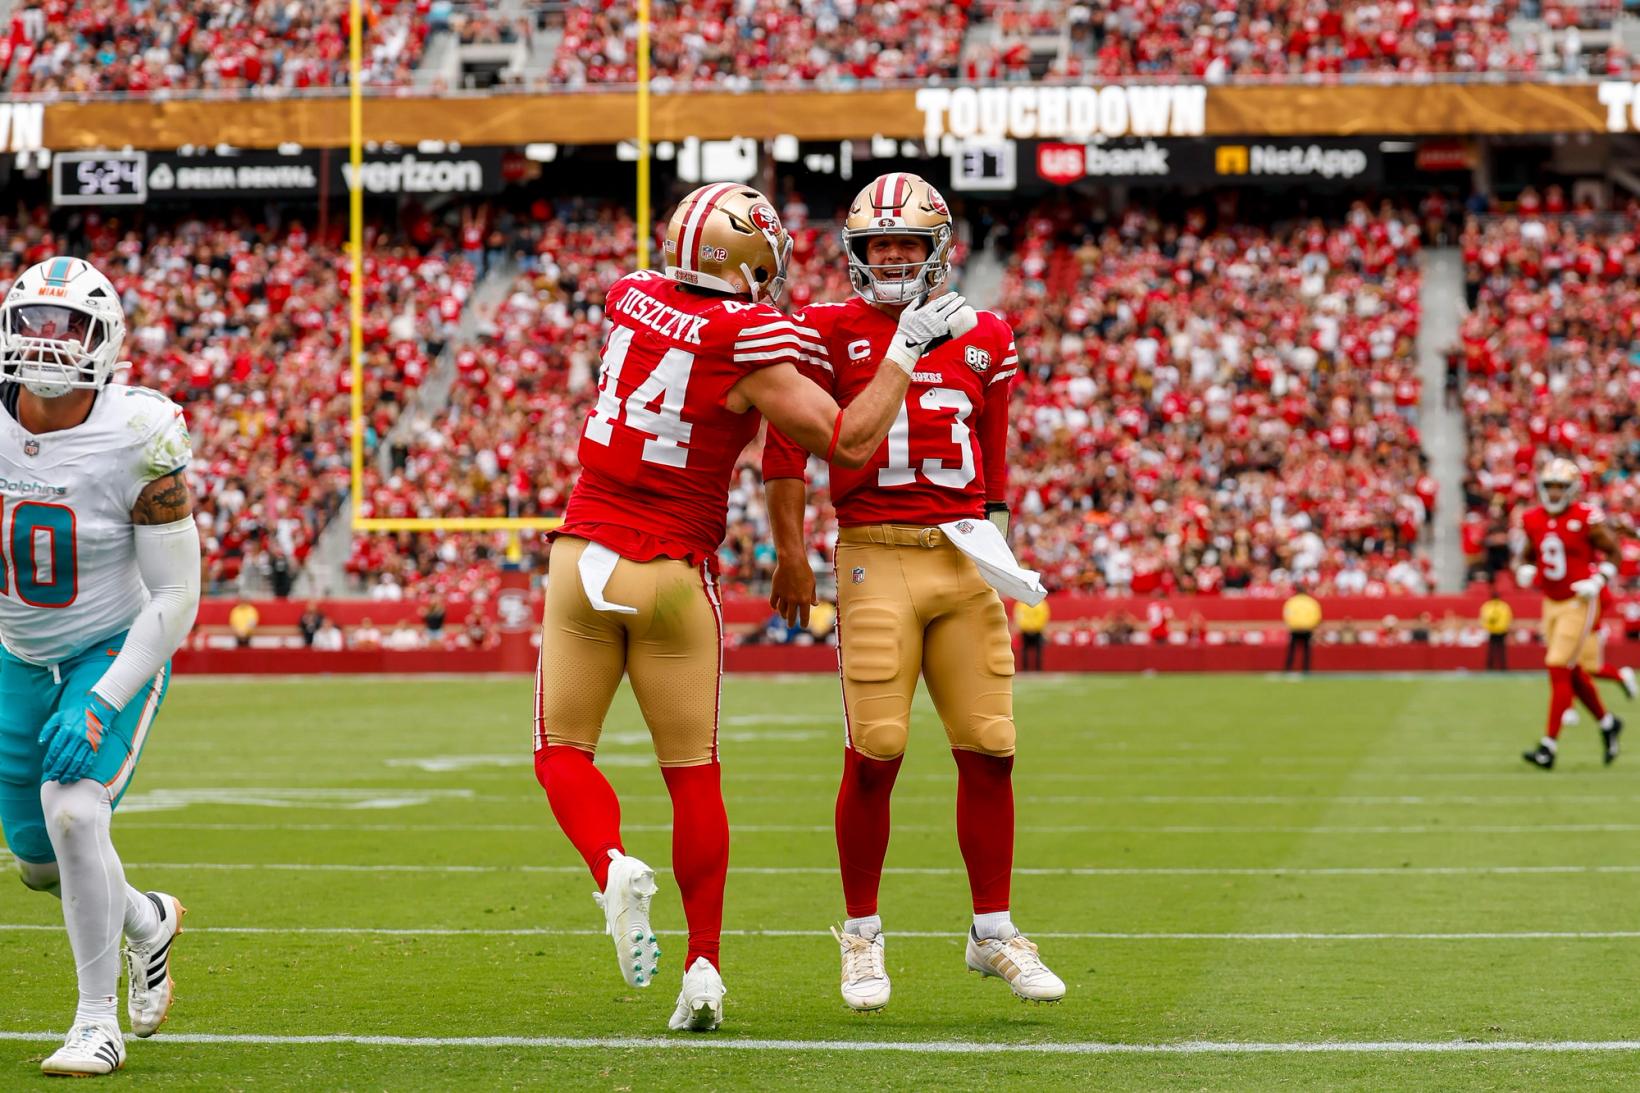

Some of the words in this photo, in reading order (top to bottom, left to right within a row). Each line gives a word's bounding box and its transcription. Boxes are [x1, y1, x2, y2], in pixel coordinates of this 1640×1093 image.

[916, 86, 1206, 139] TOUCHDOWN
[1598, 82, 1640, 132] T
[1250, 145, 1367, 178] NetApp
[38, 287, 67, 297] MIAMI
[615, 286, 710, 345] JUSZCZYK
[847, 339, 871, 361] C
[584, 324, 695, 469] 44
[878, 387, 977, 489] 13
[1540, 533, 1567, 581] 9
